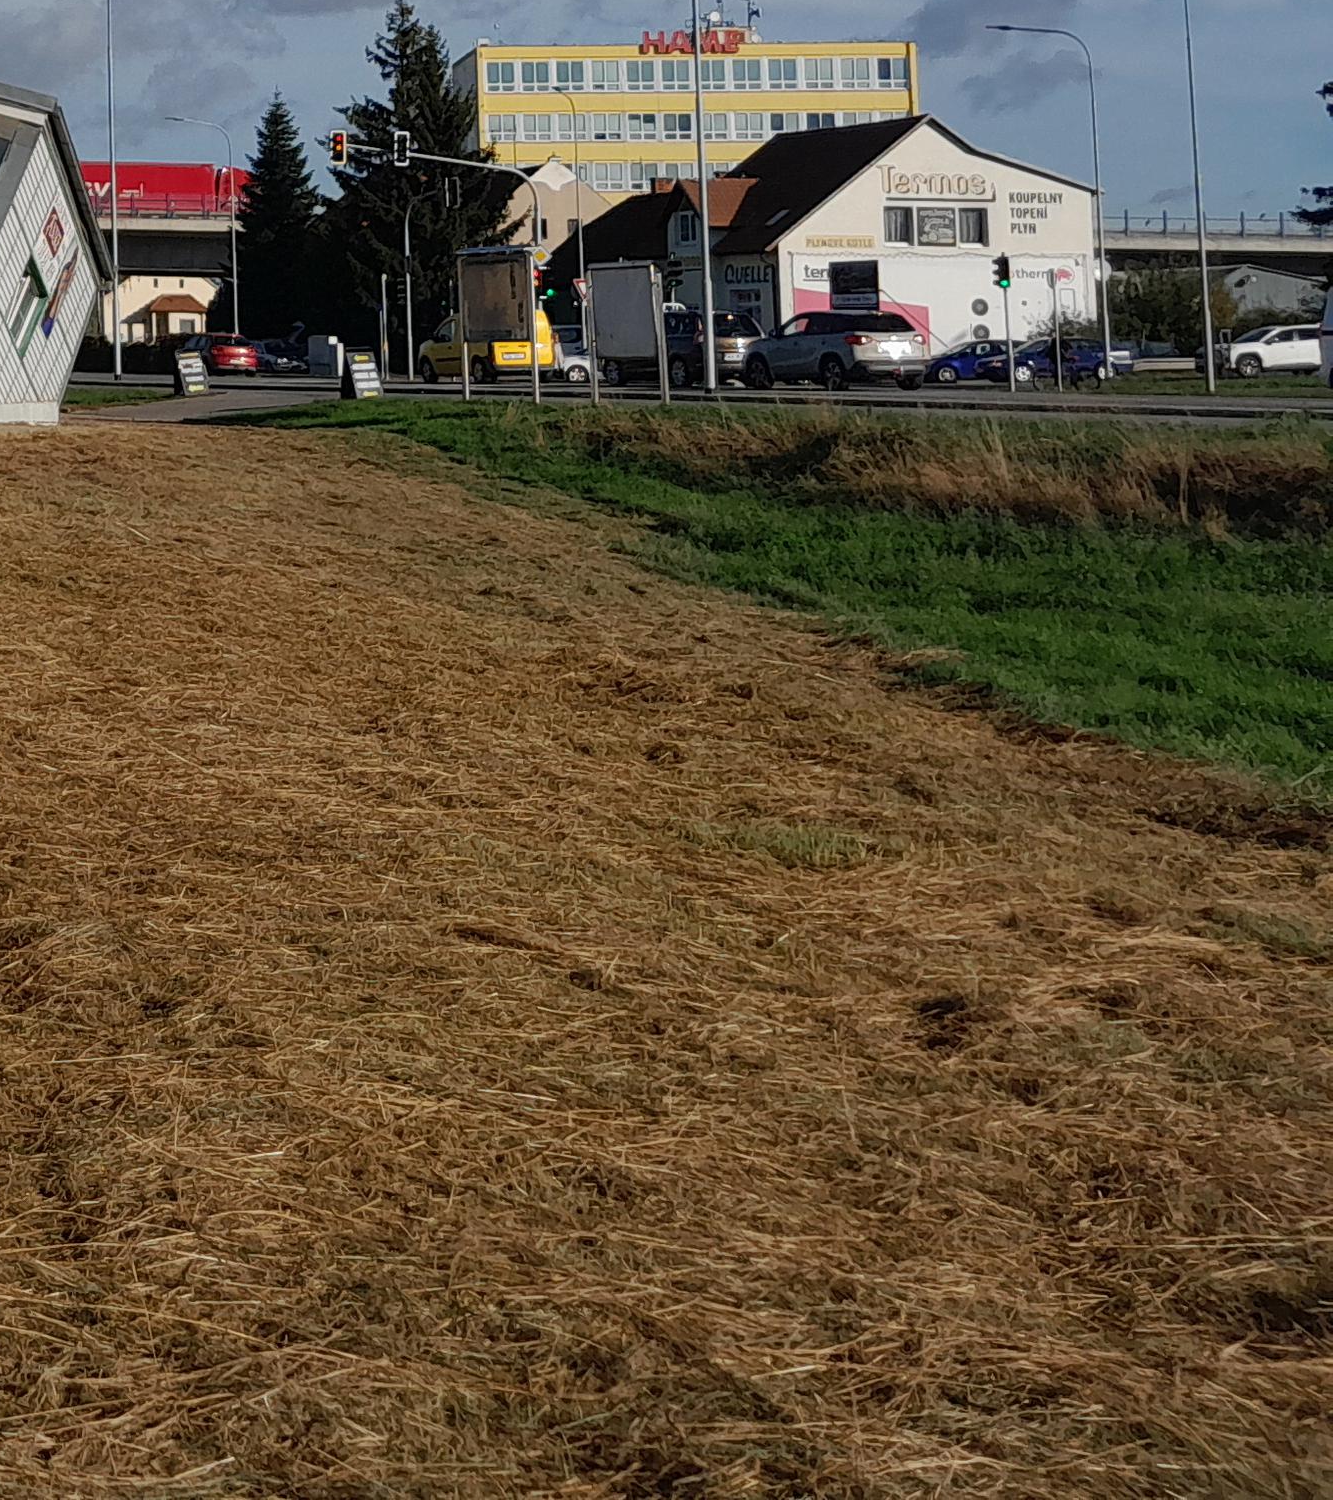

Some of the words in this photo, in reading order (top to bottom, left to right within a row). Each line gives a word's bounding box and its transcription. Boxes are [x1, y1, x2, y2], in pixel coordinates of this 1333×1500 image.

[878, 164, 987, 196] Termos
[1009, 192, 1063, 204] KOUPELNY
[1010, 205, 1048, 219] TOPENÍ
[725, 264, 770, 285] QUELLE
[803, 264, 831, 279] ter
